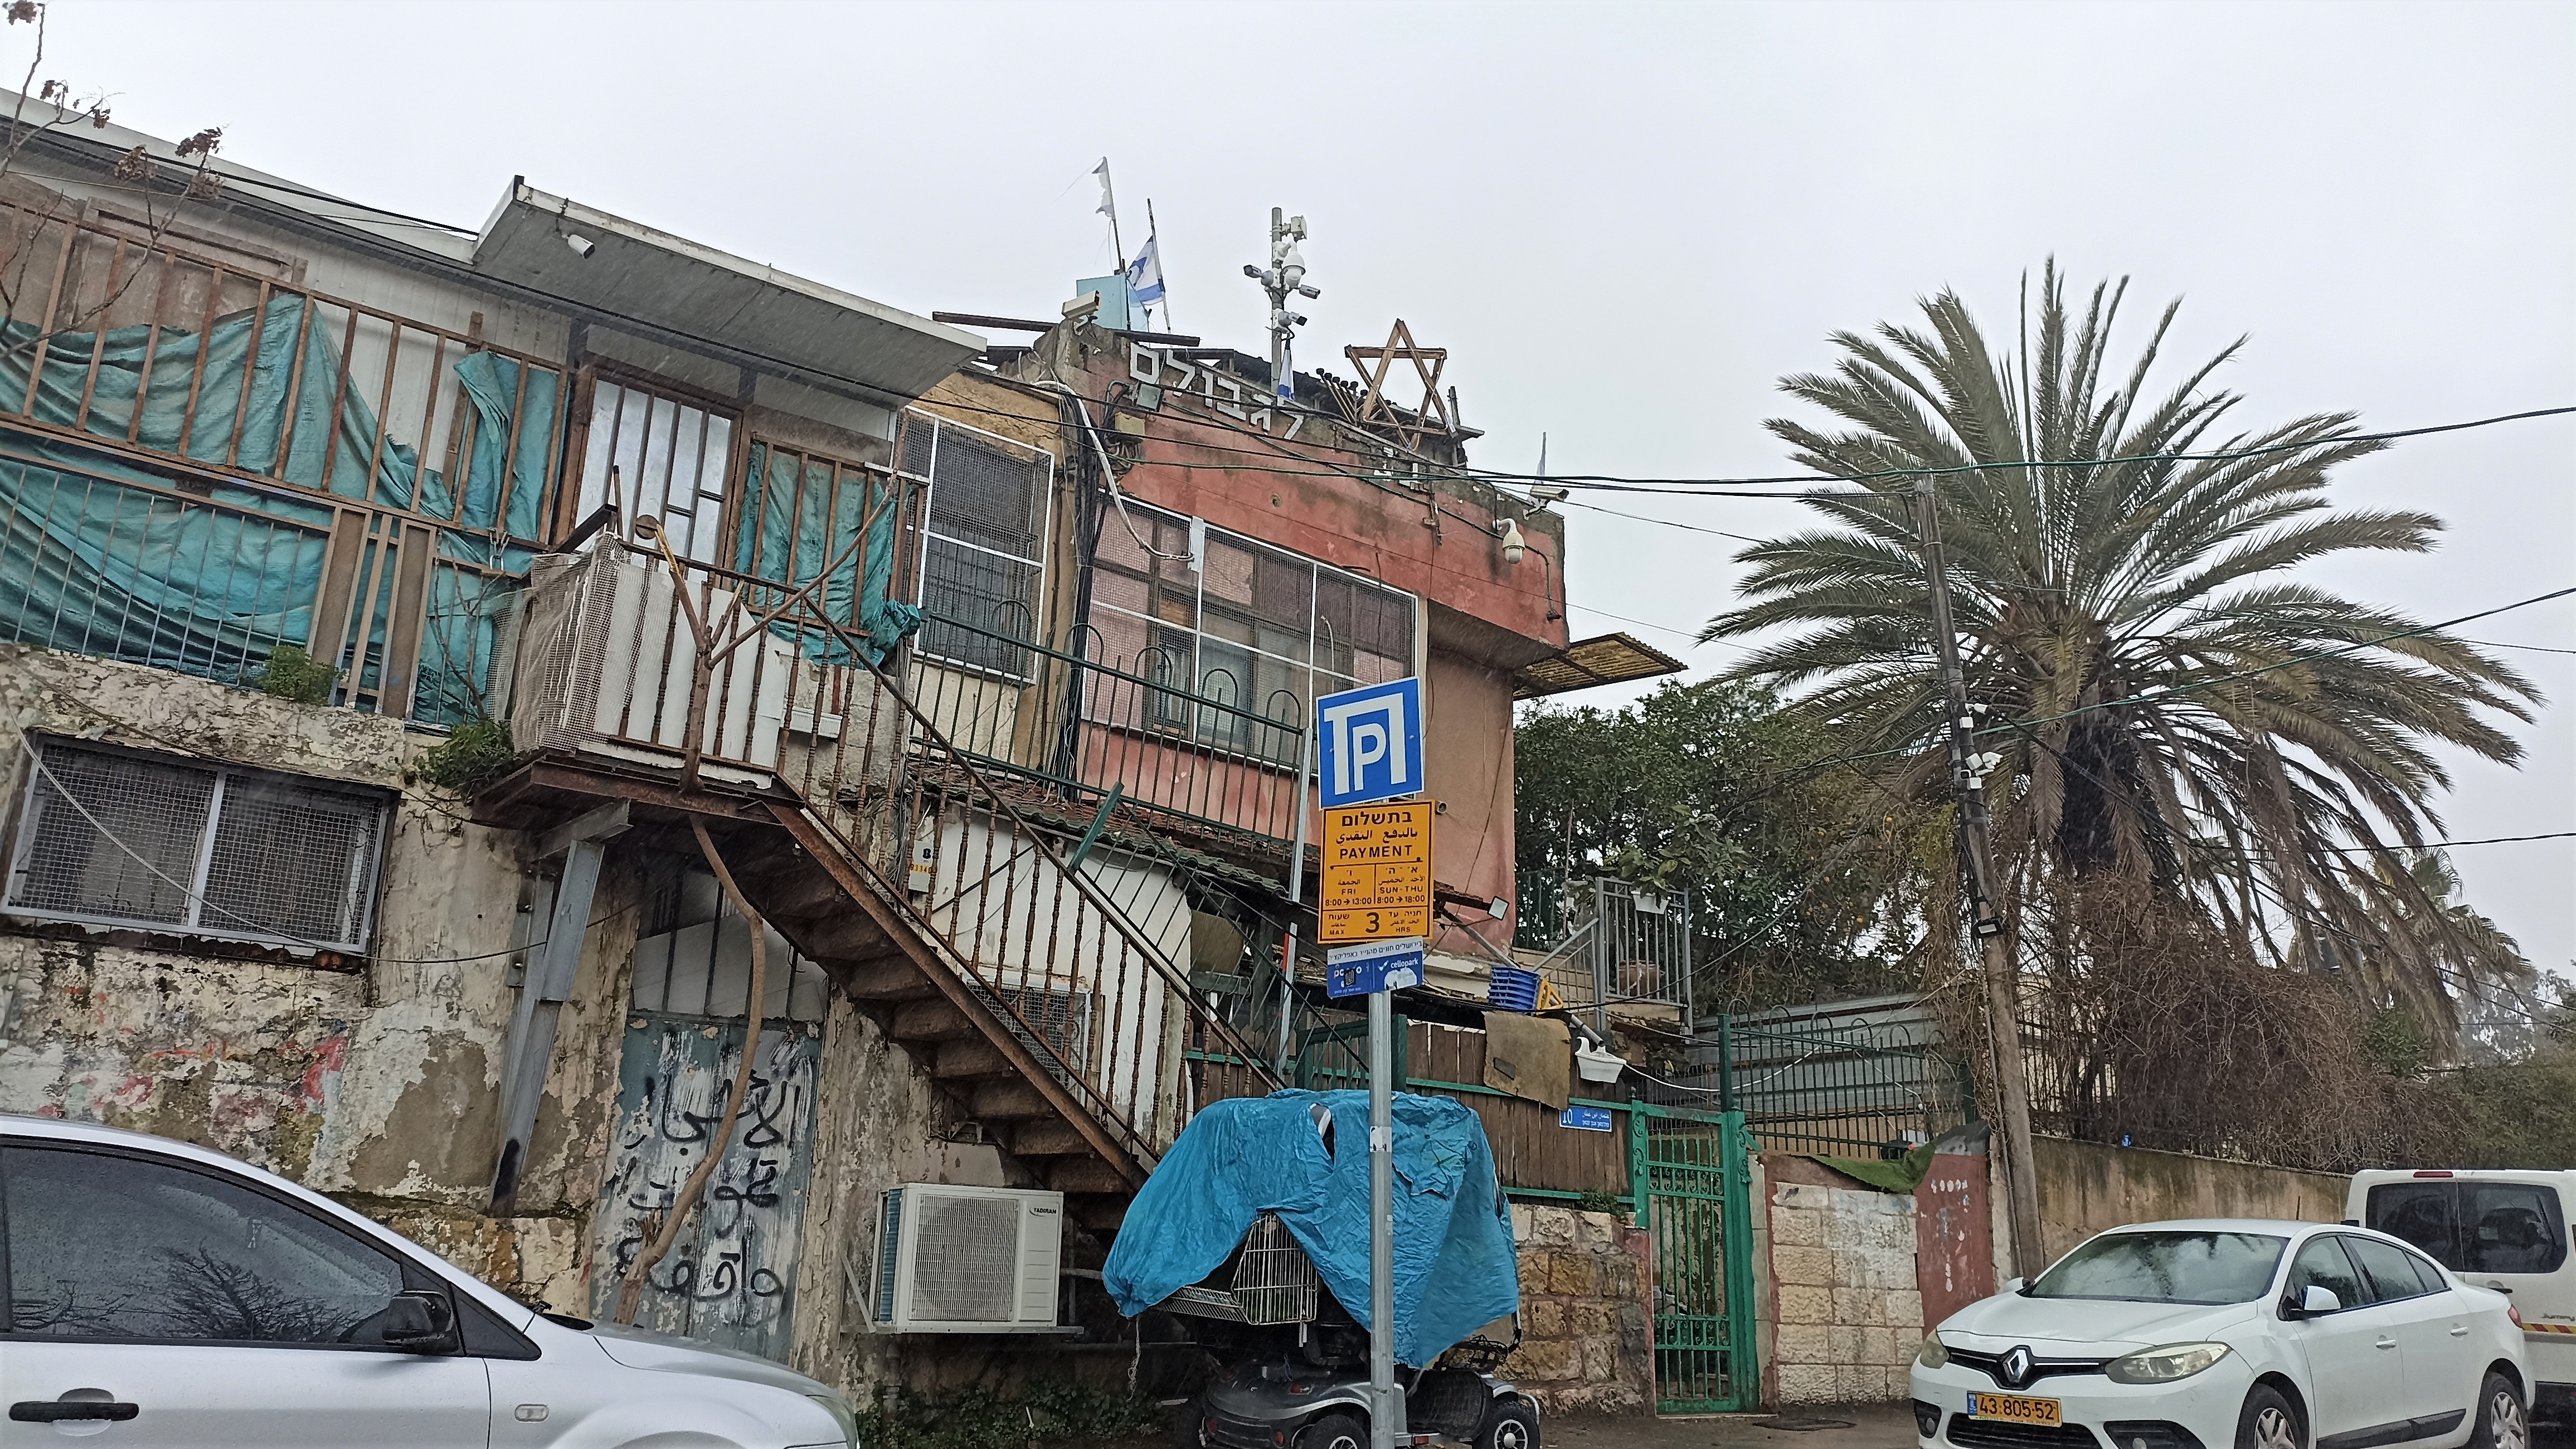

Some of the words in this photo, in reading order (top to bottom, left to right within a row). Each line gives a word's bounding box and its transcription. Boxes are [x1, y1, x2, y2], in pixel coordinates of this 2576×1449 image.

[1342, 811, 1412, 826] בתשלום
[1336, 829, 1373, 845] النقدي
[1382, 827, 1418, 843] بالدفع
[1340, 845, 1412, 859] PAYMENT
[1365, 912, 1380, 933] 3
[1378, 945, 1394, 954] חונים
[1395, 941, 1422, 950] בירושלים
[1391, 957, 1418, 969] cellopark
[1562, 1108, 1573, 1125] 10
